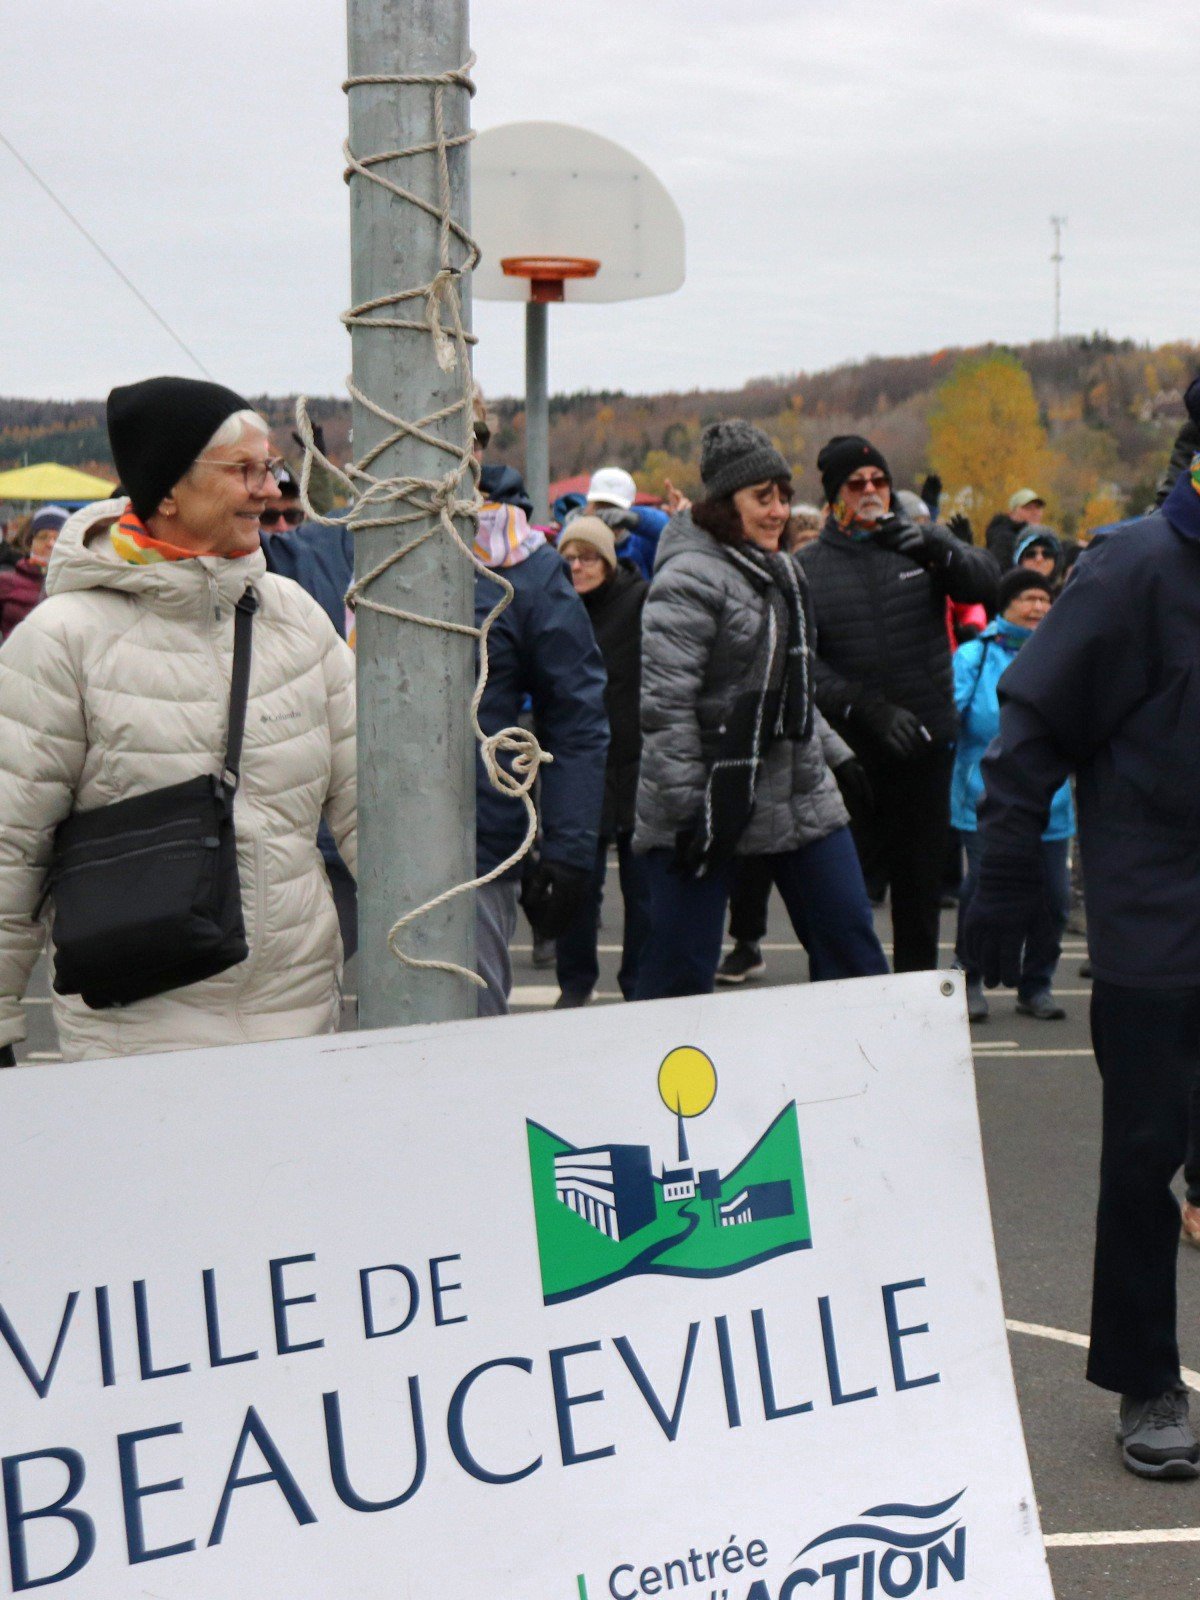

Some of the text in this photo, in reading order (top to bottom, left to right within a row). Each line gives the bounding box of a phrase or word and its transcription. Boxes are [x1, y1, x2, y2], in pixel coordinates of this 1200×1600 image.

[0, 1252, 468, 1399] VILLE DE
[1, 1277, 941, 1592] BEAUCEVILLE
[608, 1534, 769, 1600] Centrée
